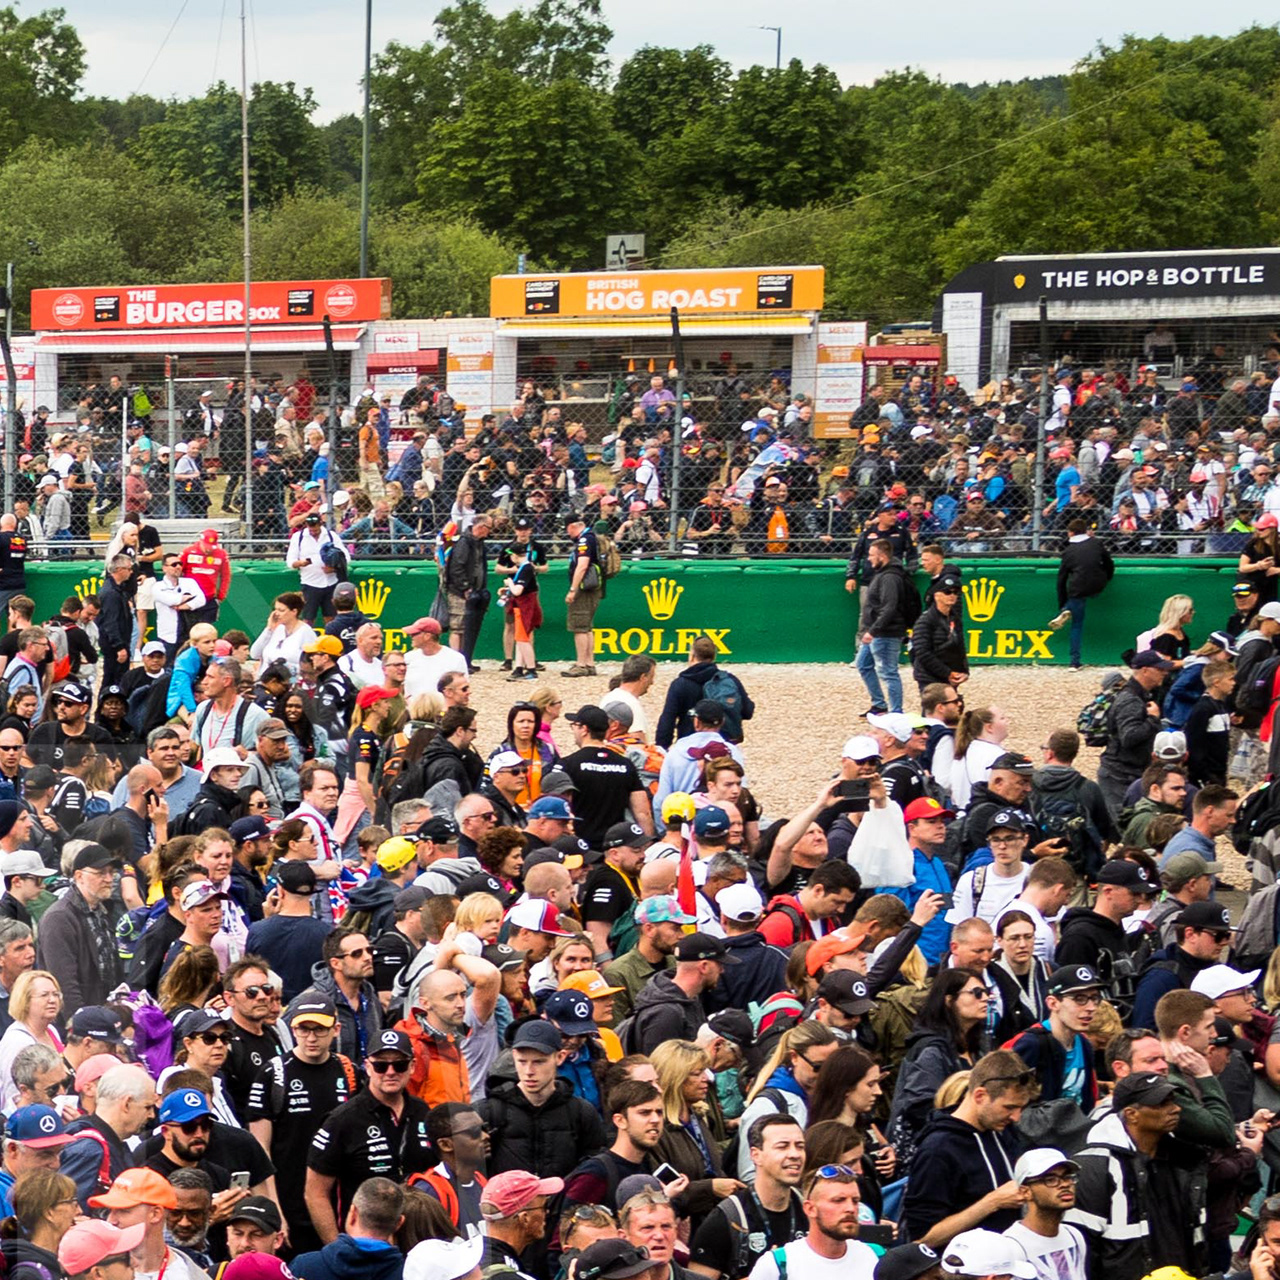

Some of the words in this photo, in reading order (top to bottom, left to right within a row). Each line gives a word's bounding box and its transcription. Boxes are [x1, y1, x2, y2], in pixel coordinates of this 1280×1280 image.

[586, 278, 639, 291] BRITISH
[1041, 270, 1089, 289] THE
[1096, 268, 1144, 288] HOP
[1146, 269, 1159, 285] &
[1162, 265, 1265, 286] BOTTLE
[126, 290, 156, 302] THE
[585, 291, 645, 312] HOG
[651, 288, 742, 309] ROAST
[126, 299, 244, 325] BURGER
[247, 307, 280, 321] BOX
[592, 628, 733, 655] ROLEX
[965, 630, 1055, 660] LEX
[580, 762, 628, 774] PETRONAS
